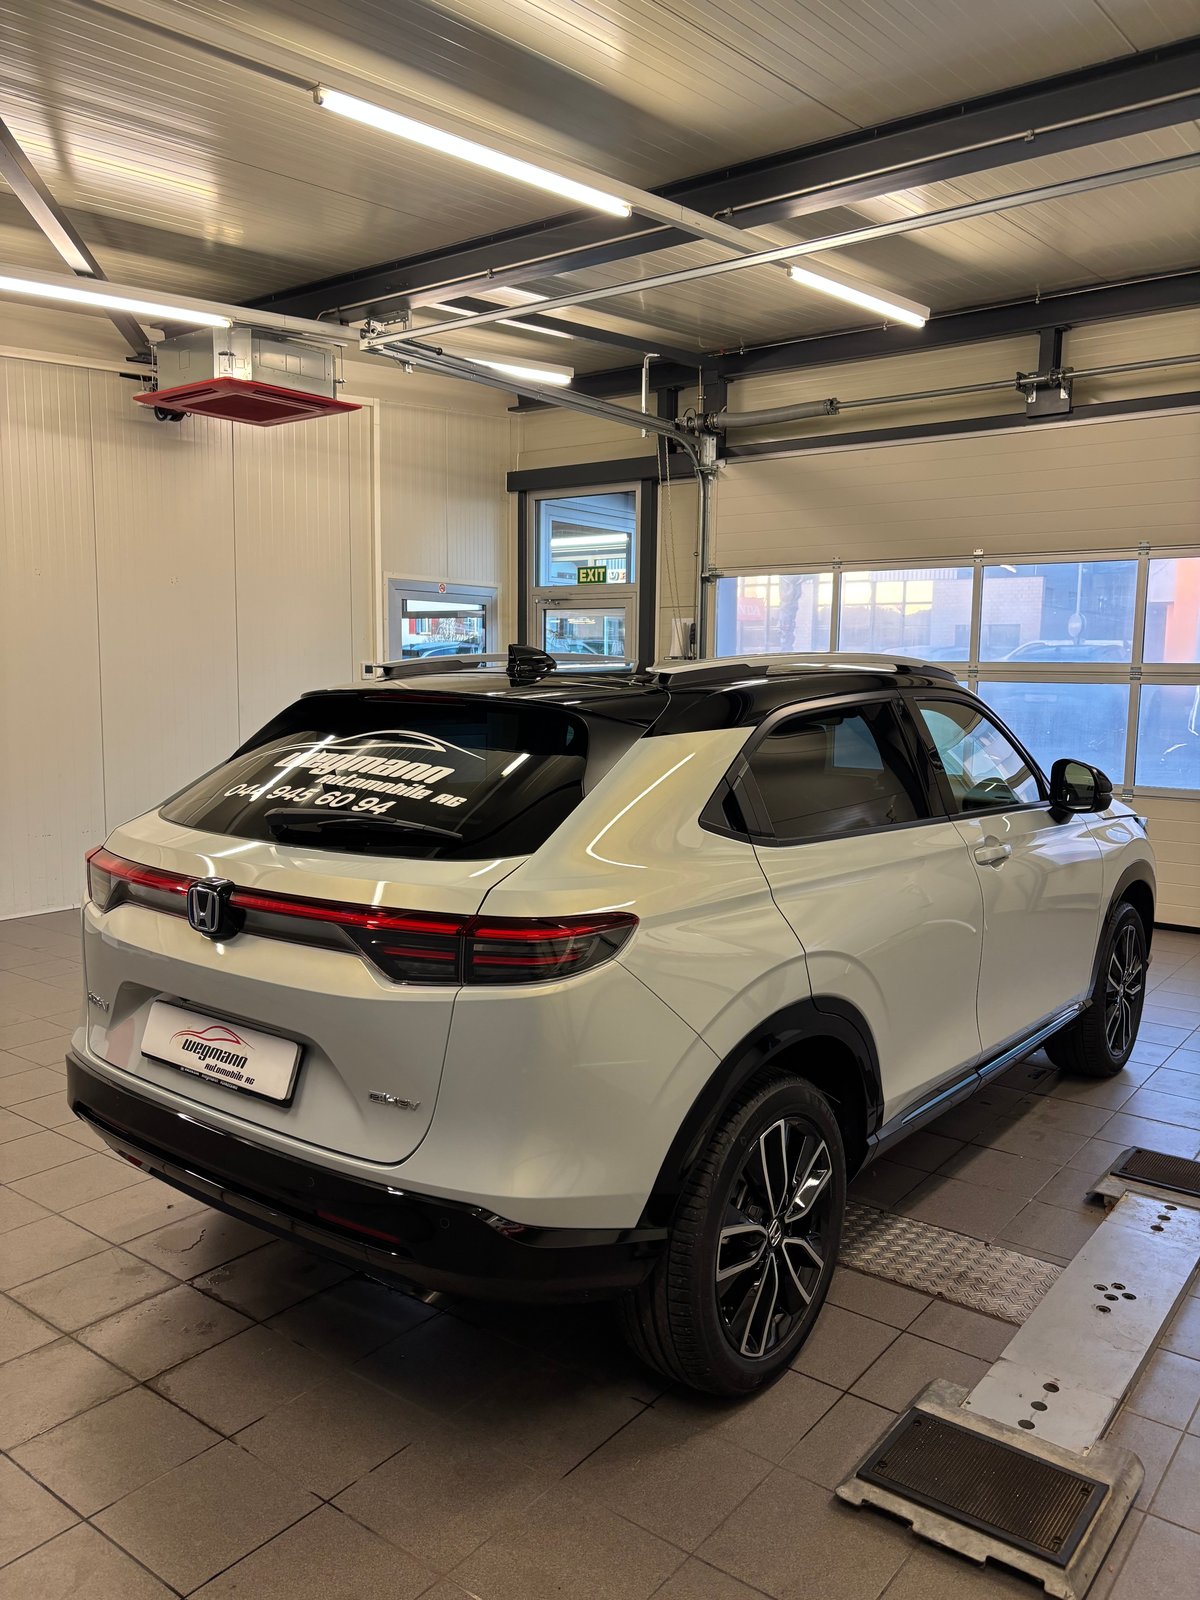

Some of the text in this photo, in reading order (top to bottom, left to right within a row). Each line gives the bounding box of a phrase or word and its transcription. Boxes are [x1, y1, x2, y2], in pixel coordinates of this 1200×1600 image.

[579, 568, 605, 582] EXIT
[266, 786, 316, 802] 945
[314, 792, 356, 808] 60
[352, 799, 396, 815] 94
[431, 793, 467, 808] AG
[244, 1077, 256, 1086] AG
